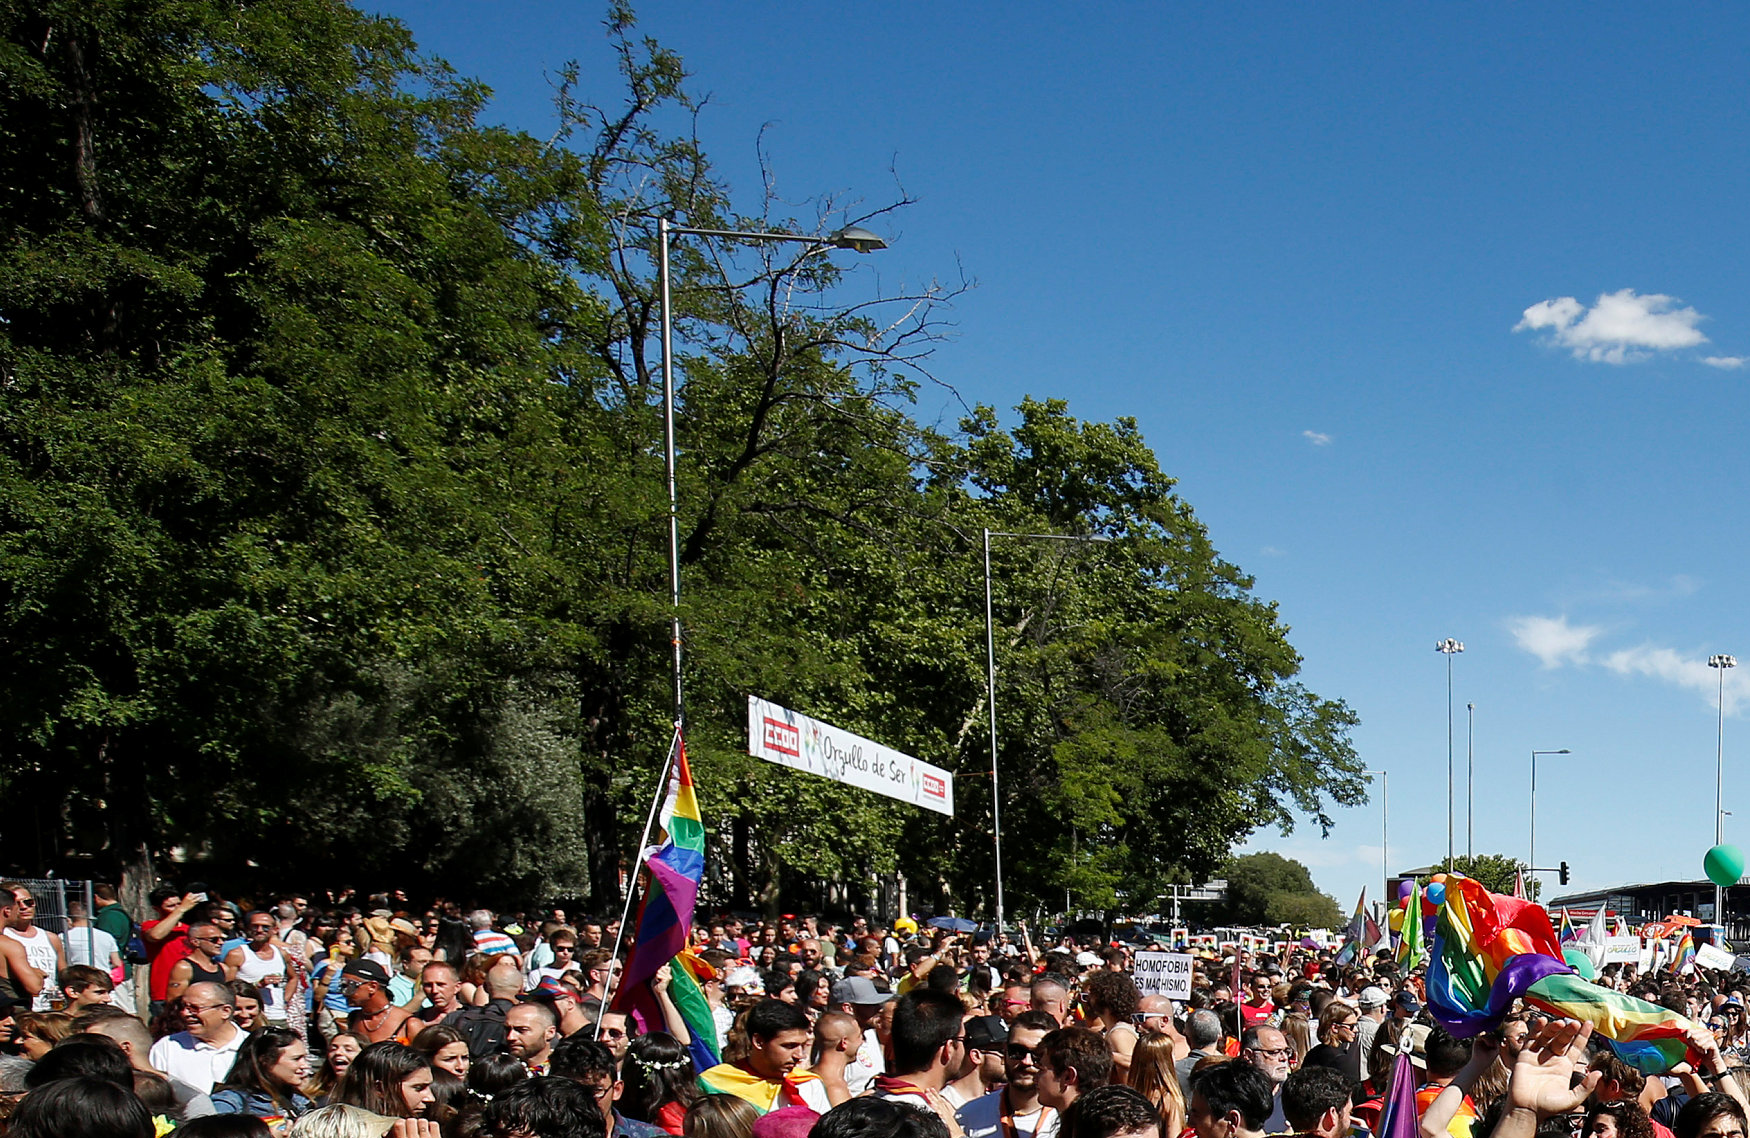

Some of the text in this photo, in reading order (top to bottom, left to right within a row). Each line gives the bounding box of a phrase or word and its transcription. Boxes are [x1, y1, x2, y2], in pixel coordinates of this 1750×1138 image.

[765, 723, 905, 785] CCOO Orgullo de Ser
[1135, 959, 1189, 974] HOMOFOBIA
[1134, 977, 1189, 992] ES MACHISMO.
